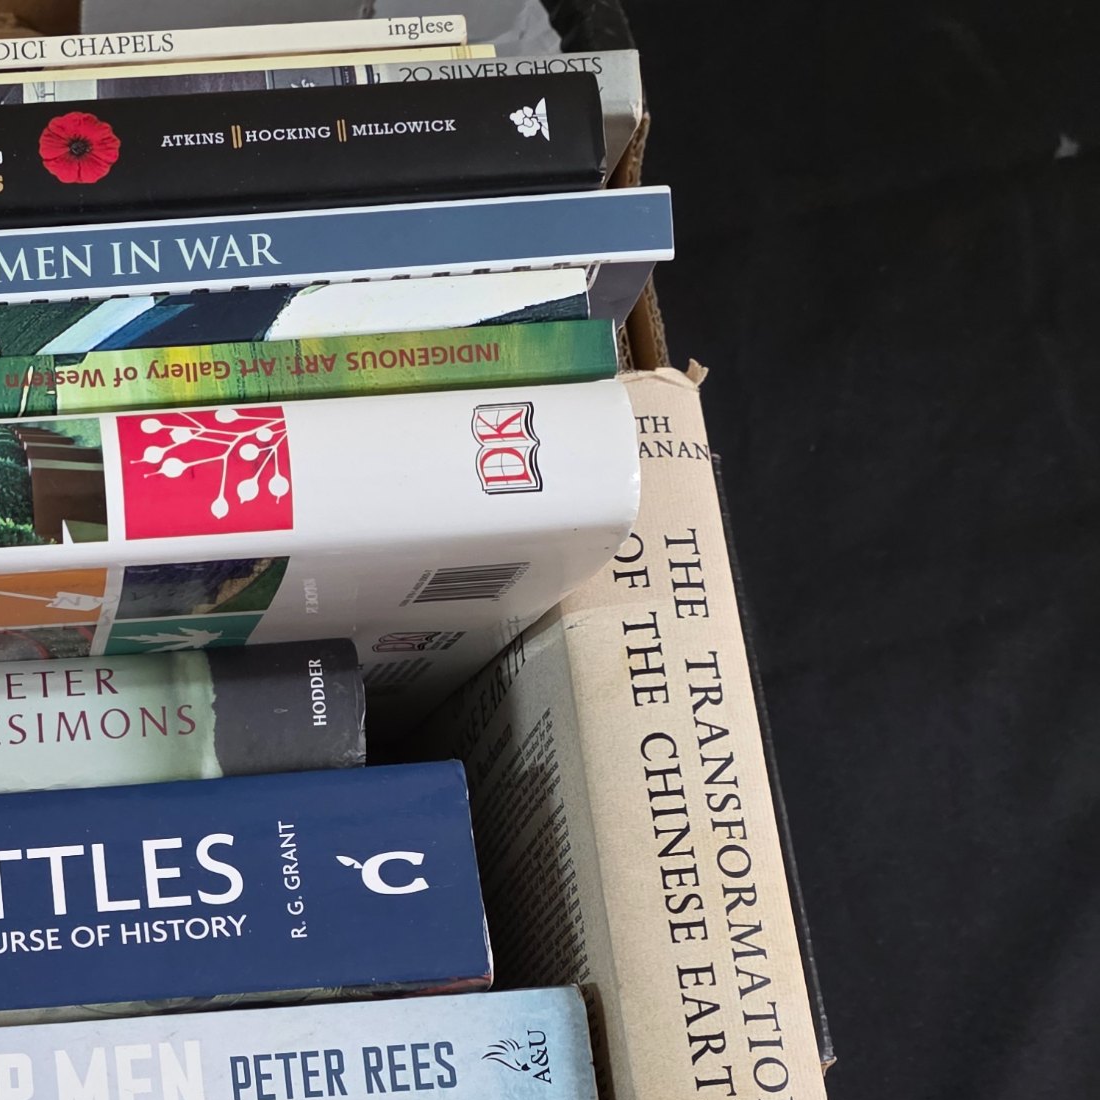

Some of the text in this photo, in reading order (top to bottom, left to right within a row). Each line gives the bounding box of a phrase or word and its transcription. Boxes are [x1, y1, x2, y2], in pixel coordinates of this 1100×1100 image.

[60, 33, 174, 58] CHAPELS
[388, 18, 454, 39] inglese
[516, 57, 603, 75] GHOSTS
[161, 119, 457, 148] ATKINS HOCKING MILLOWICK
[110, 238, 162, 276] IN
[175, 232, 282, 270] WAR
[113, 366, 137, 381] of
[146, 358, 231, 384] Gallery
[239, 357, 276, 375] Art
[286, 353, 336, 375] ART:
[347, 342, 500, 371] INDIGENOUS
[5, 368, 106, 388] Western
[476, 407, 534, 487] DK
[613, 532, 650, 588] OF
[663, 528, 709, 619] THE
[622, 611, 669, 706] THE
[308, 659, 327, 726] HODDER
[640, 732, 710, 944] CHINESE
[278, 821, 308, 939] R. G. GRANT
[71, 922, 110, 948] OF
[120, 914, 247, 945] HISTORY
[362, 1041, 458, 1094] REES
[527, 1029, 552, 1085] A&U
